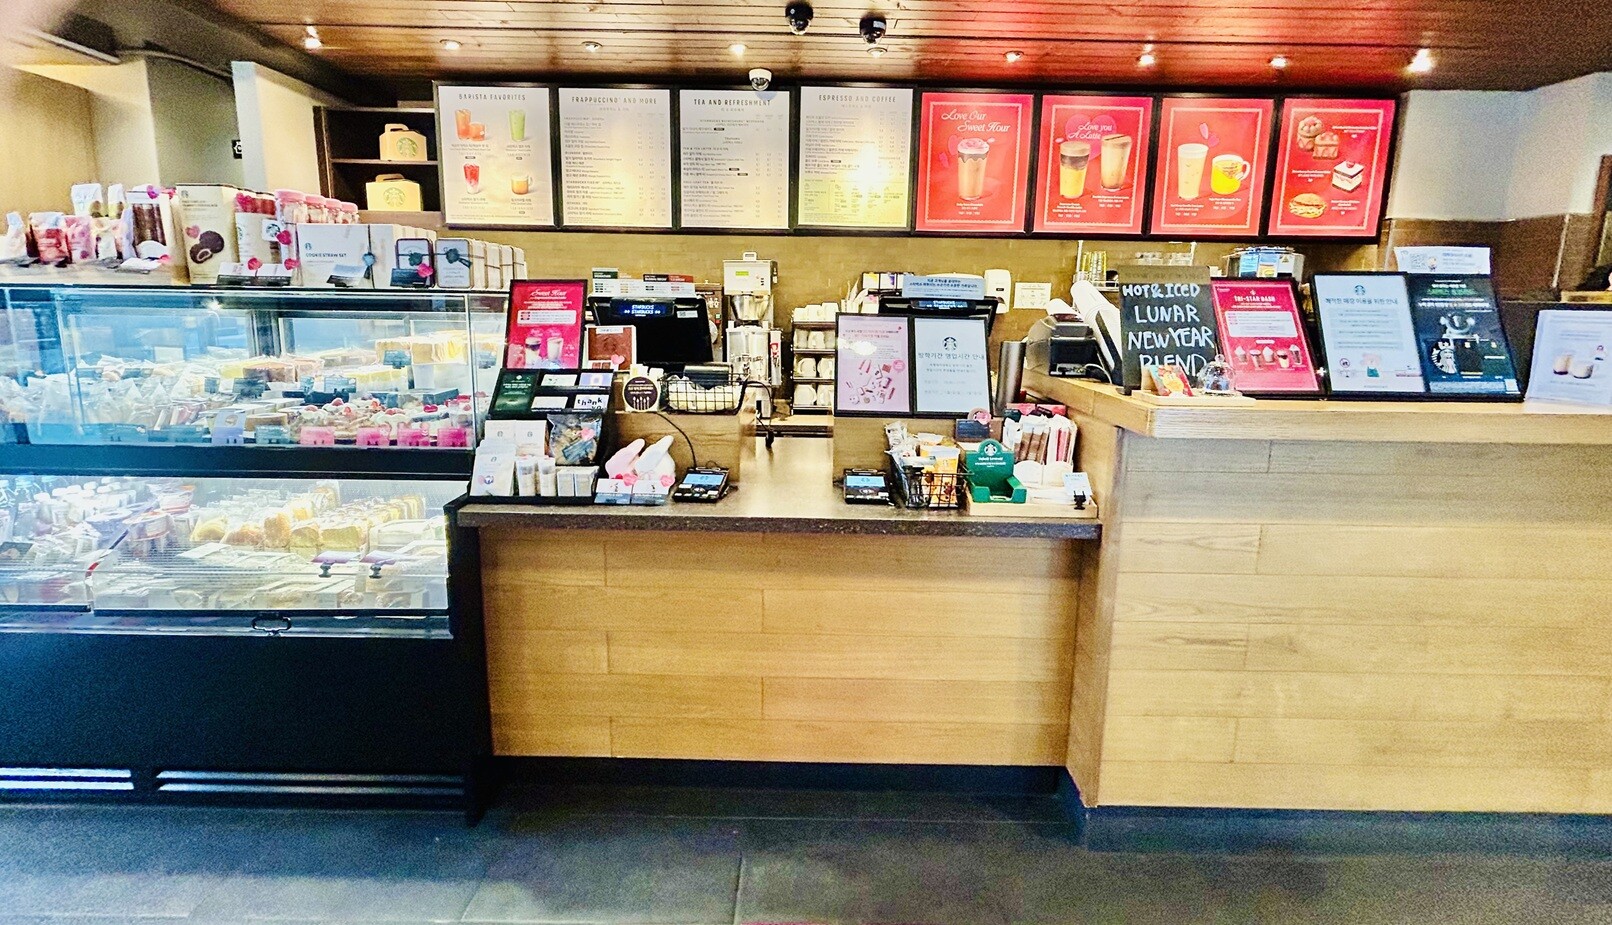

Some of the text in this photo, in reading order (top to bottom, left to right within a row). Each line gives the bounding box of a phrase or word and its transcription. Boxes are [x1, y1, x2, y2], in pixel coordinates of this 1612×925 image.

[639, 97, 657, 105] MORE
[694, 98, 771, 107] TEA AND REFRESHMENT
[819, 94, 853, 102] ESPRESSO
[941, 109, 987, 120] Love Our
[957, 120, 1011, 133] Sweet Hour
[1078, 121, 1113, 133] Love you
[1079, 131, 1102, 140] Latte
[530, 287, 567, 297] Sweet Hour
[1134, 303, 1200, 324] LUNAR
[1127, 325, 1215, 351] NEW YEAR
